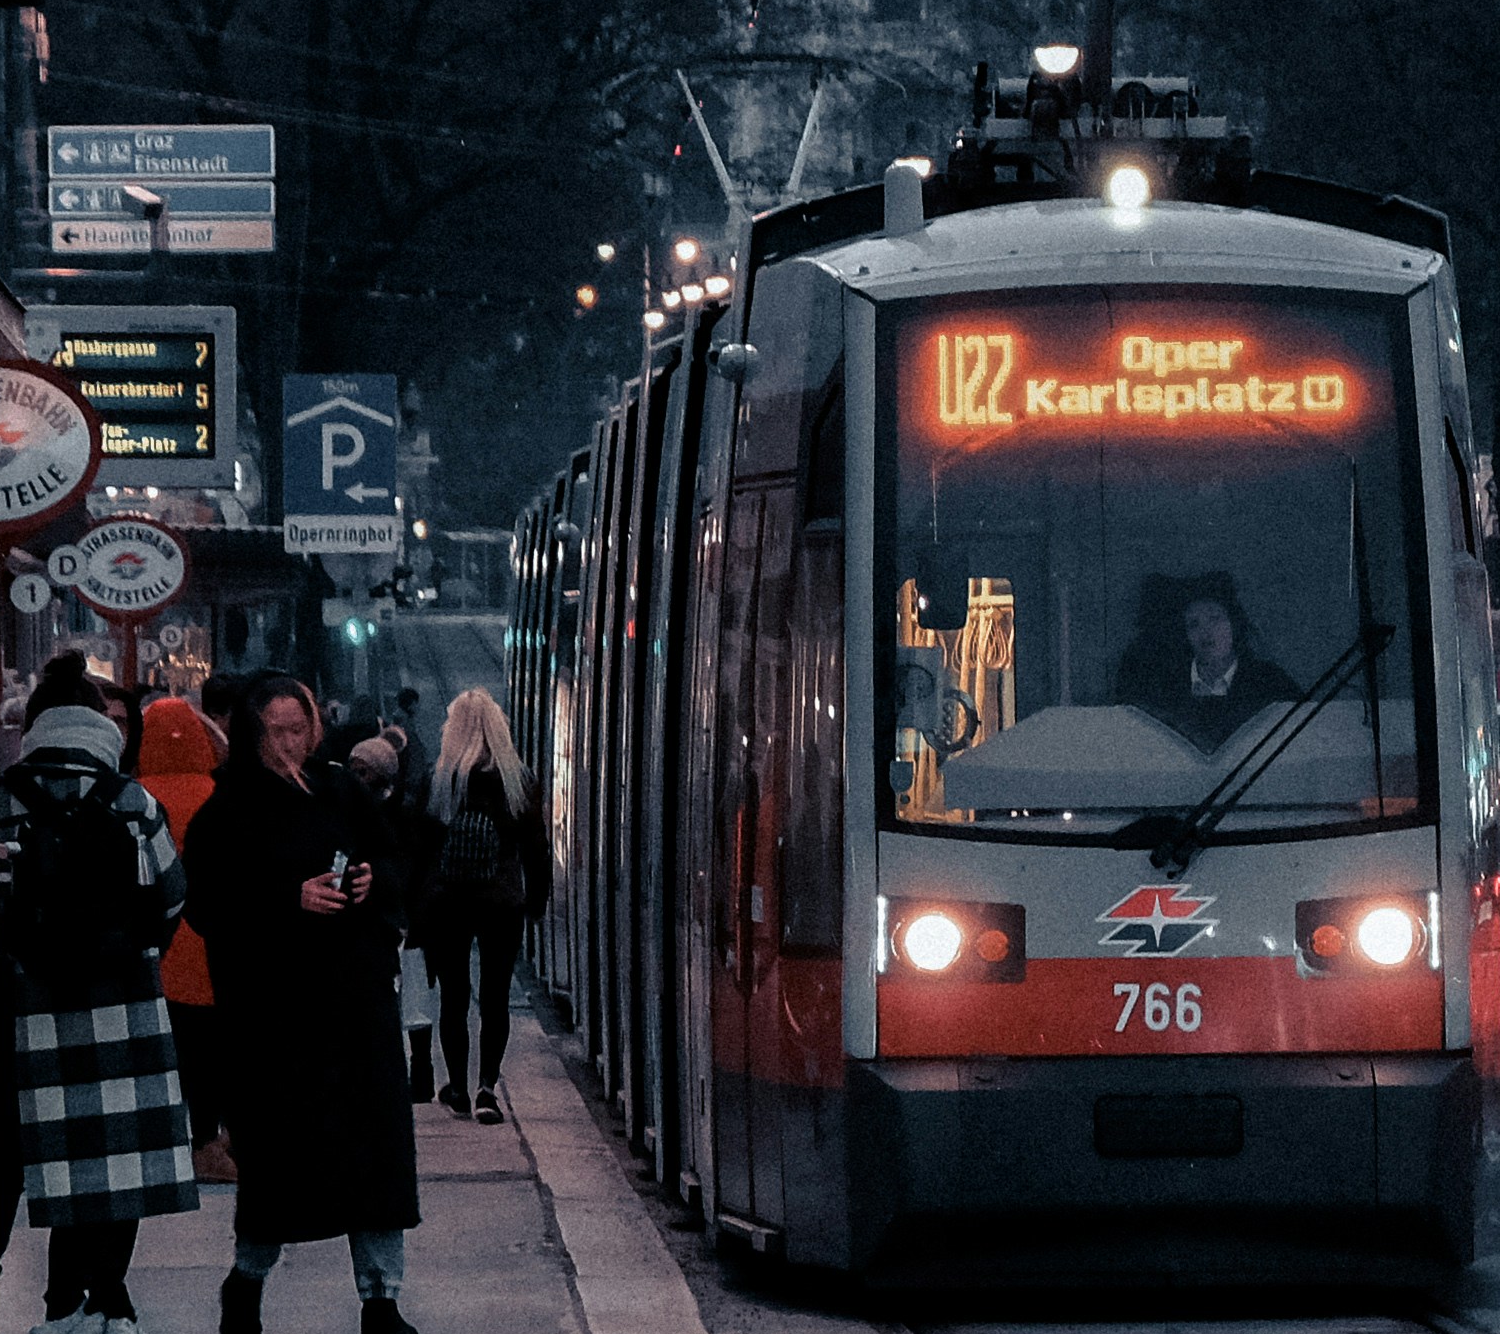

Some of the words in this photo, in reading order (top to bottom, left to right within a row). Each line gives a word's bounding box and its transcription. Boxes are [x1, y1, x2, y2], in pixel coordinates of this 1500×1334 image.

[135, 133, 175, 150] Graz
[135, 155, 229, 173] Eisenstadt
[85, 228, 214, 246] Hauptbnhof
[195, 341, 208, 368] 7
[1121, 335, 1243, 377] Oper
[195, 383, 209, 410] 5
[1025, 376, 1296, 419] Karlsplatz
[196, 424, 208, 452] 2
[322, 422, 366, 491] P
[288, 523, 393, 547] Opernringhof
[59, 554, 78, 577] D
[24, 582, 37, 605] 1
[1113, 982, 1203, 1034] 766
